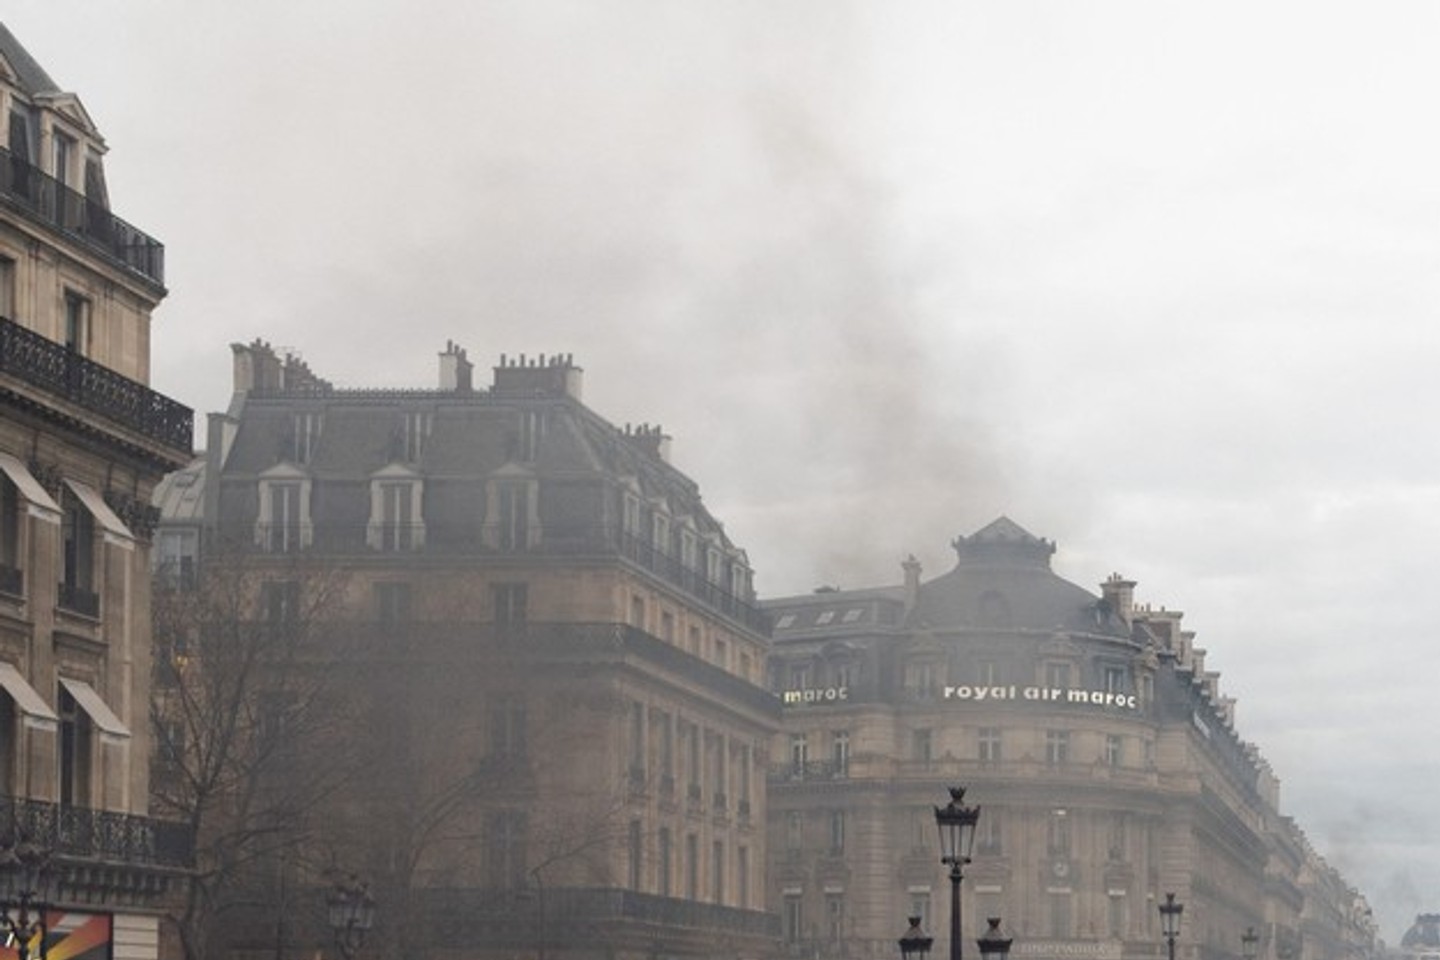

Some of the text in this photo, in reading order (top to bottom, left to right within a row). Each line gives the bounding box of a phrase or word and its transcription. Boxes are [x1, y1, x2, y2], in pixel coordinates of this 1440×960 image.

[785, 687, 848, 703] maroc
[944, 686, 1136, 709] royal air maroc
